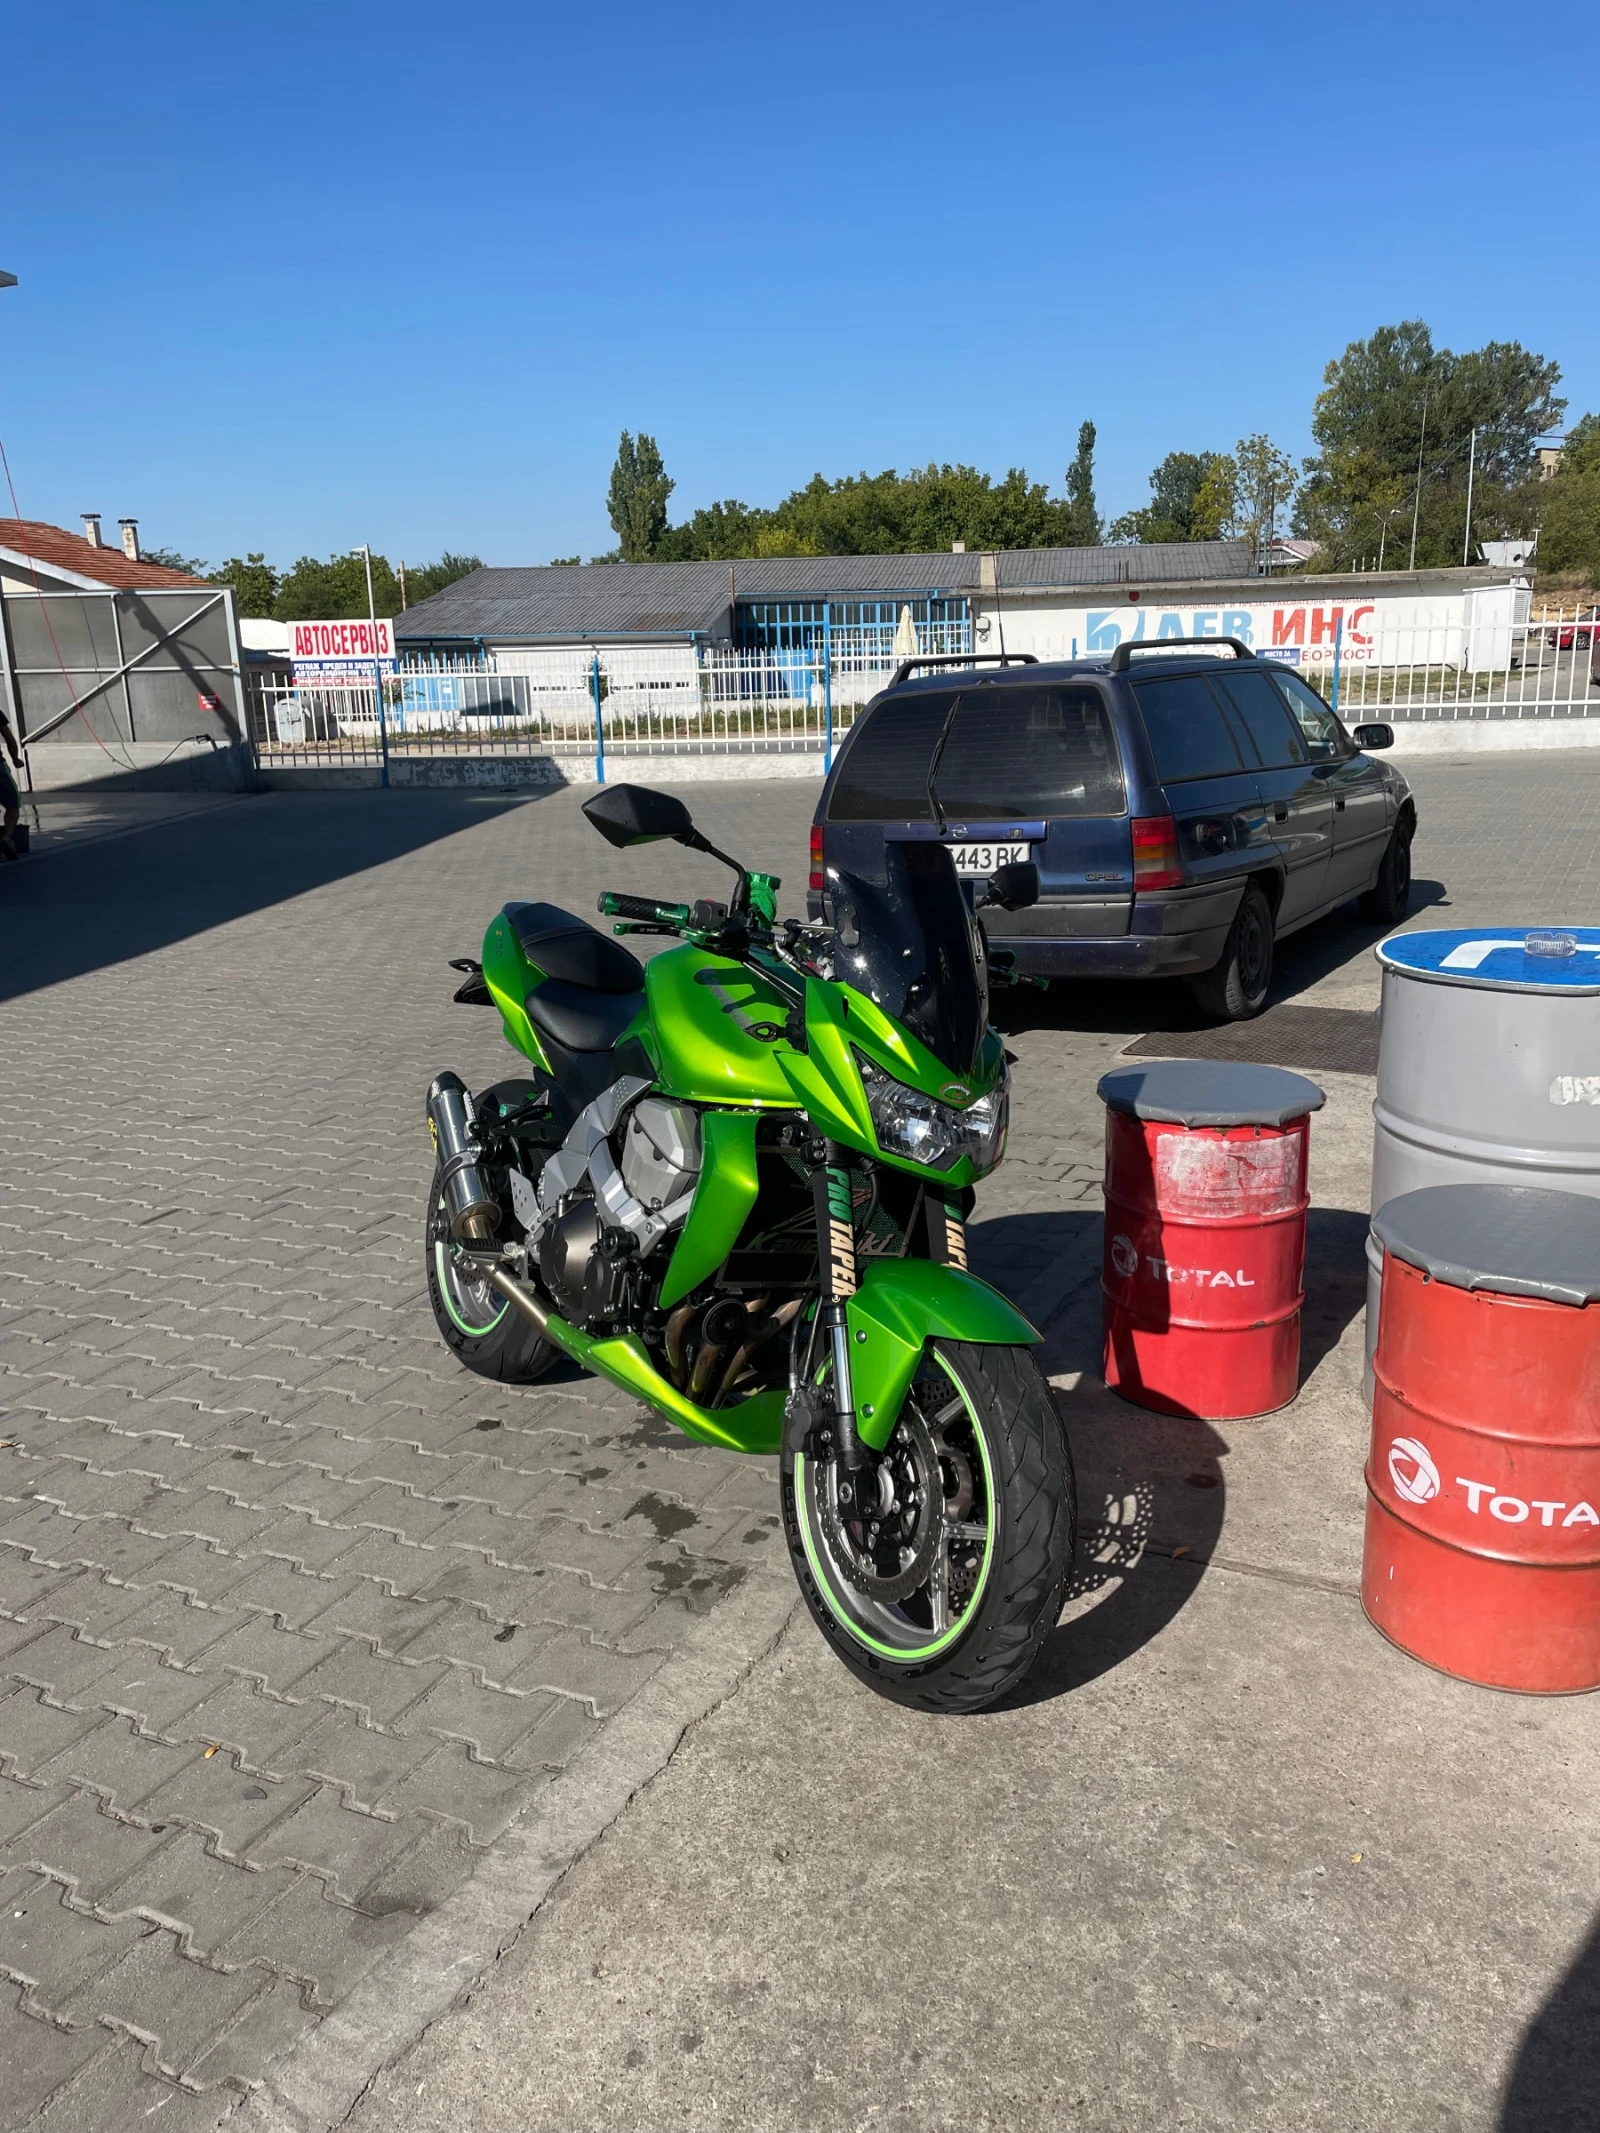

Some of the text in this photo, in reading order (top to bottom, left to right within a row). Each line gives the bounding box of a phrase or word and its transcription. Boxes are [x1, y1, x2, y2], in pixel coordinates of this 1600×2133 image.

[296, 624, 388, 655] АВТОСЕРВИЗ
[1272, 606, 1375, 646] ИНС
[1301, 649, 1375, 661] ВОРНОСТ
[948, 847, 992, 870] 443
[1085, 872, 1125, 882] OPEL
[826, 1165, 857, 1296] PRO TAPER
[1146, 1255, 1256, 1288] TOTAL
[1455, 1476, 1600, 1528] TOTA
